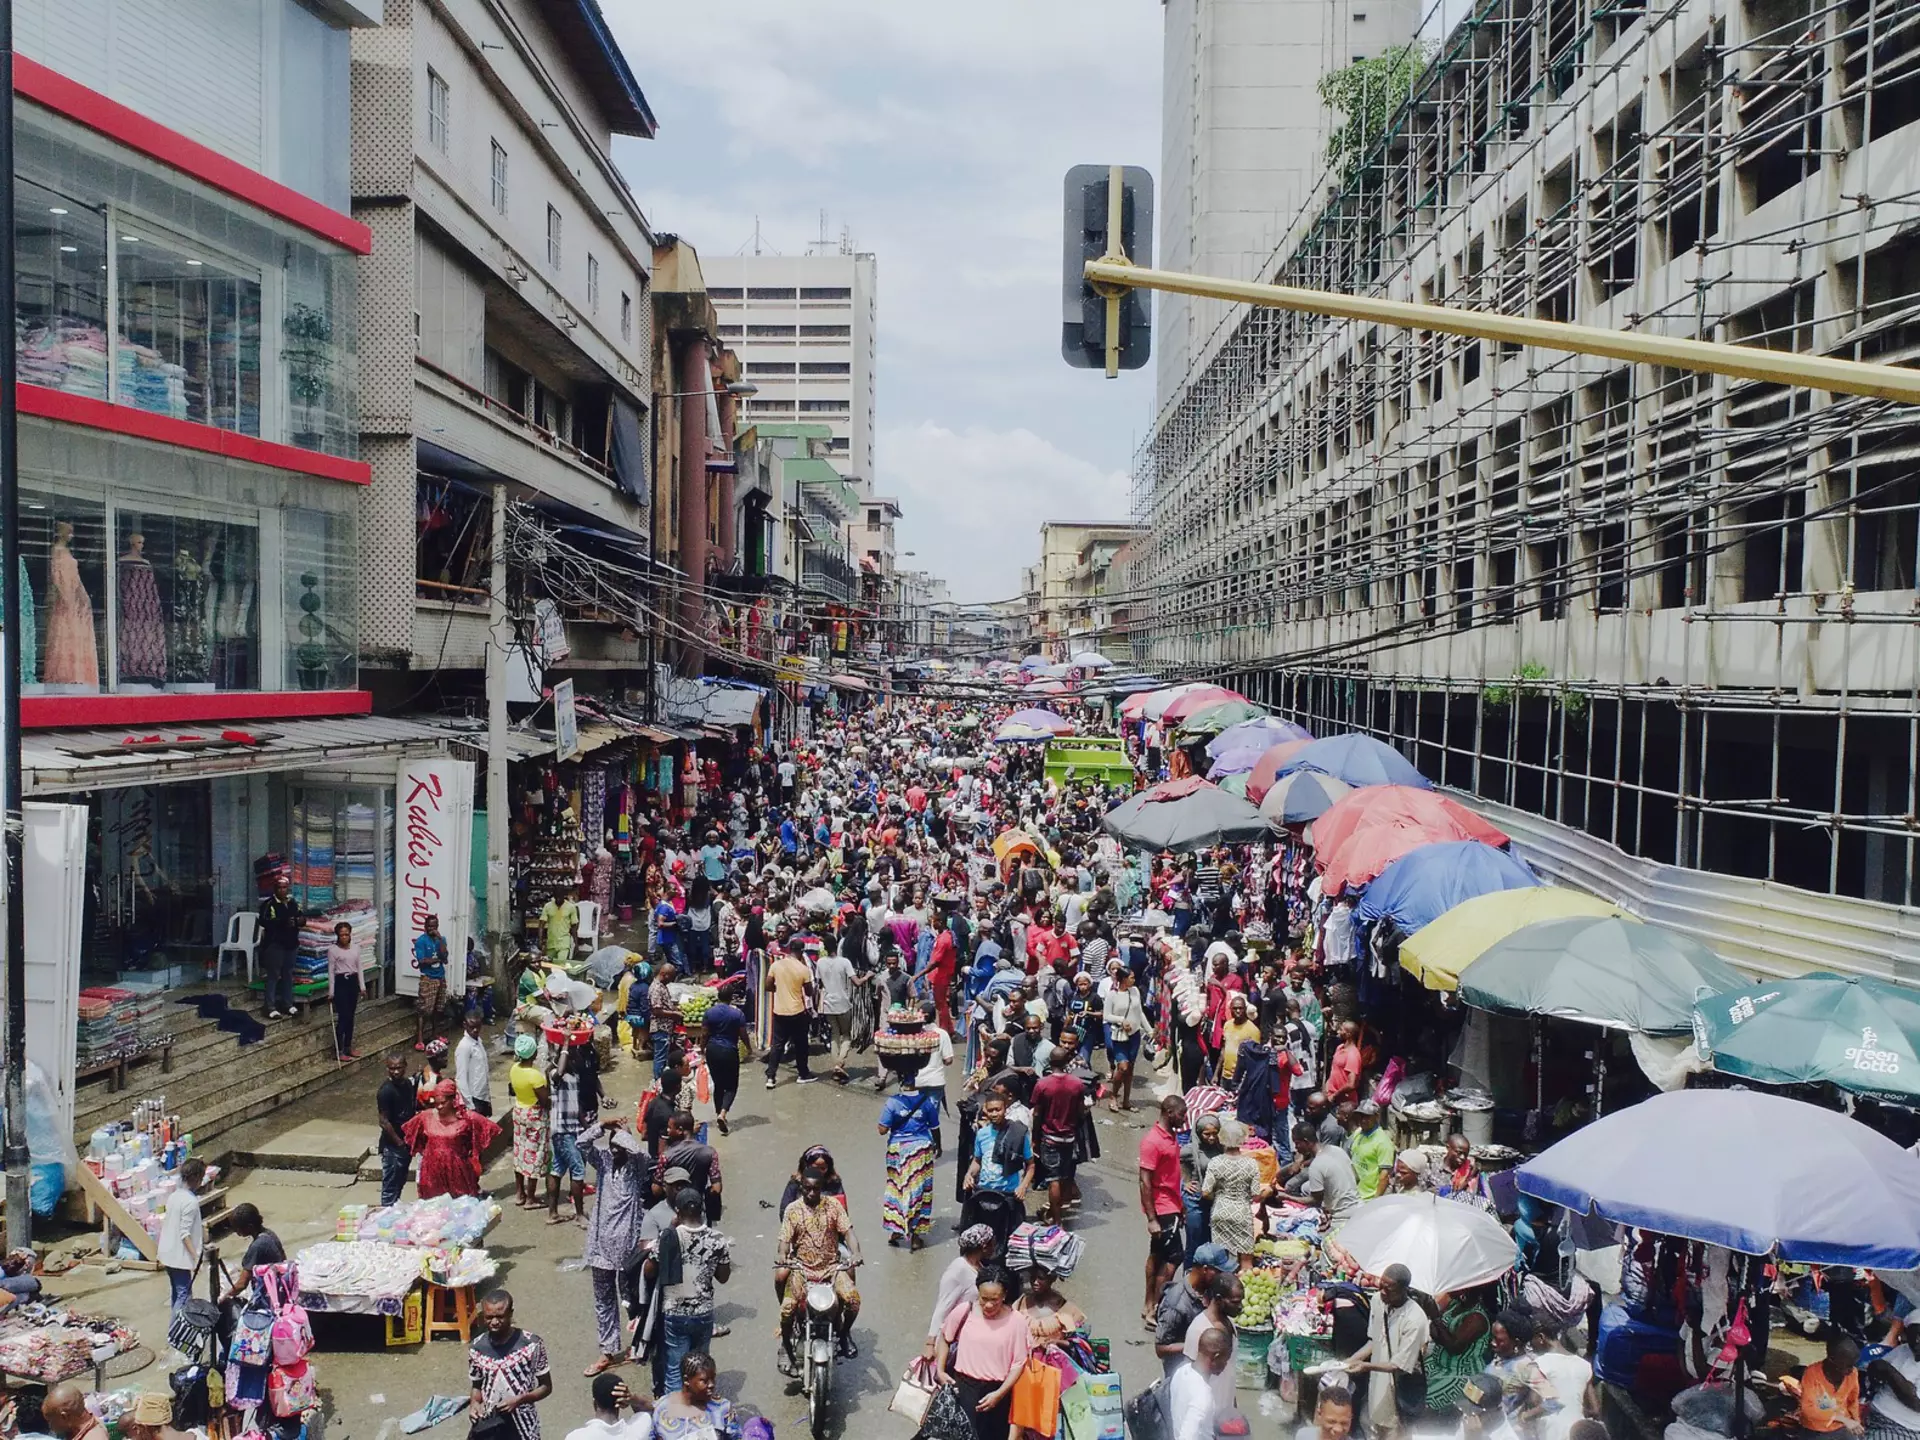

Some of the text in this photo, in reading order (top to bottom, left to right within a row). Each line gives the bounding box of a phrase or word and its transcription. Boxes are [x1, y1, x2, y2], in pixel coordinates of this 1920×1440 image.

[405, 773, 443, 970] Kubis fabrs
[1844, 1048, 1899, 1063] green
[1853, 1059, 1899, 1075] lotto
